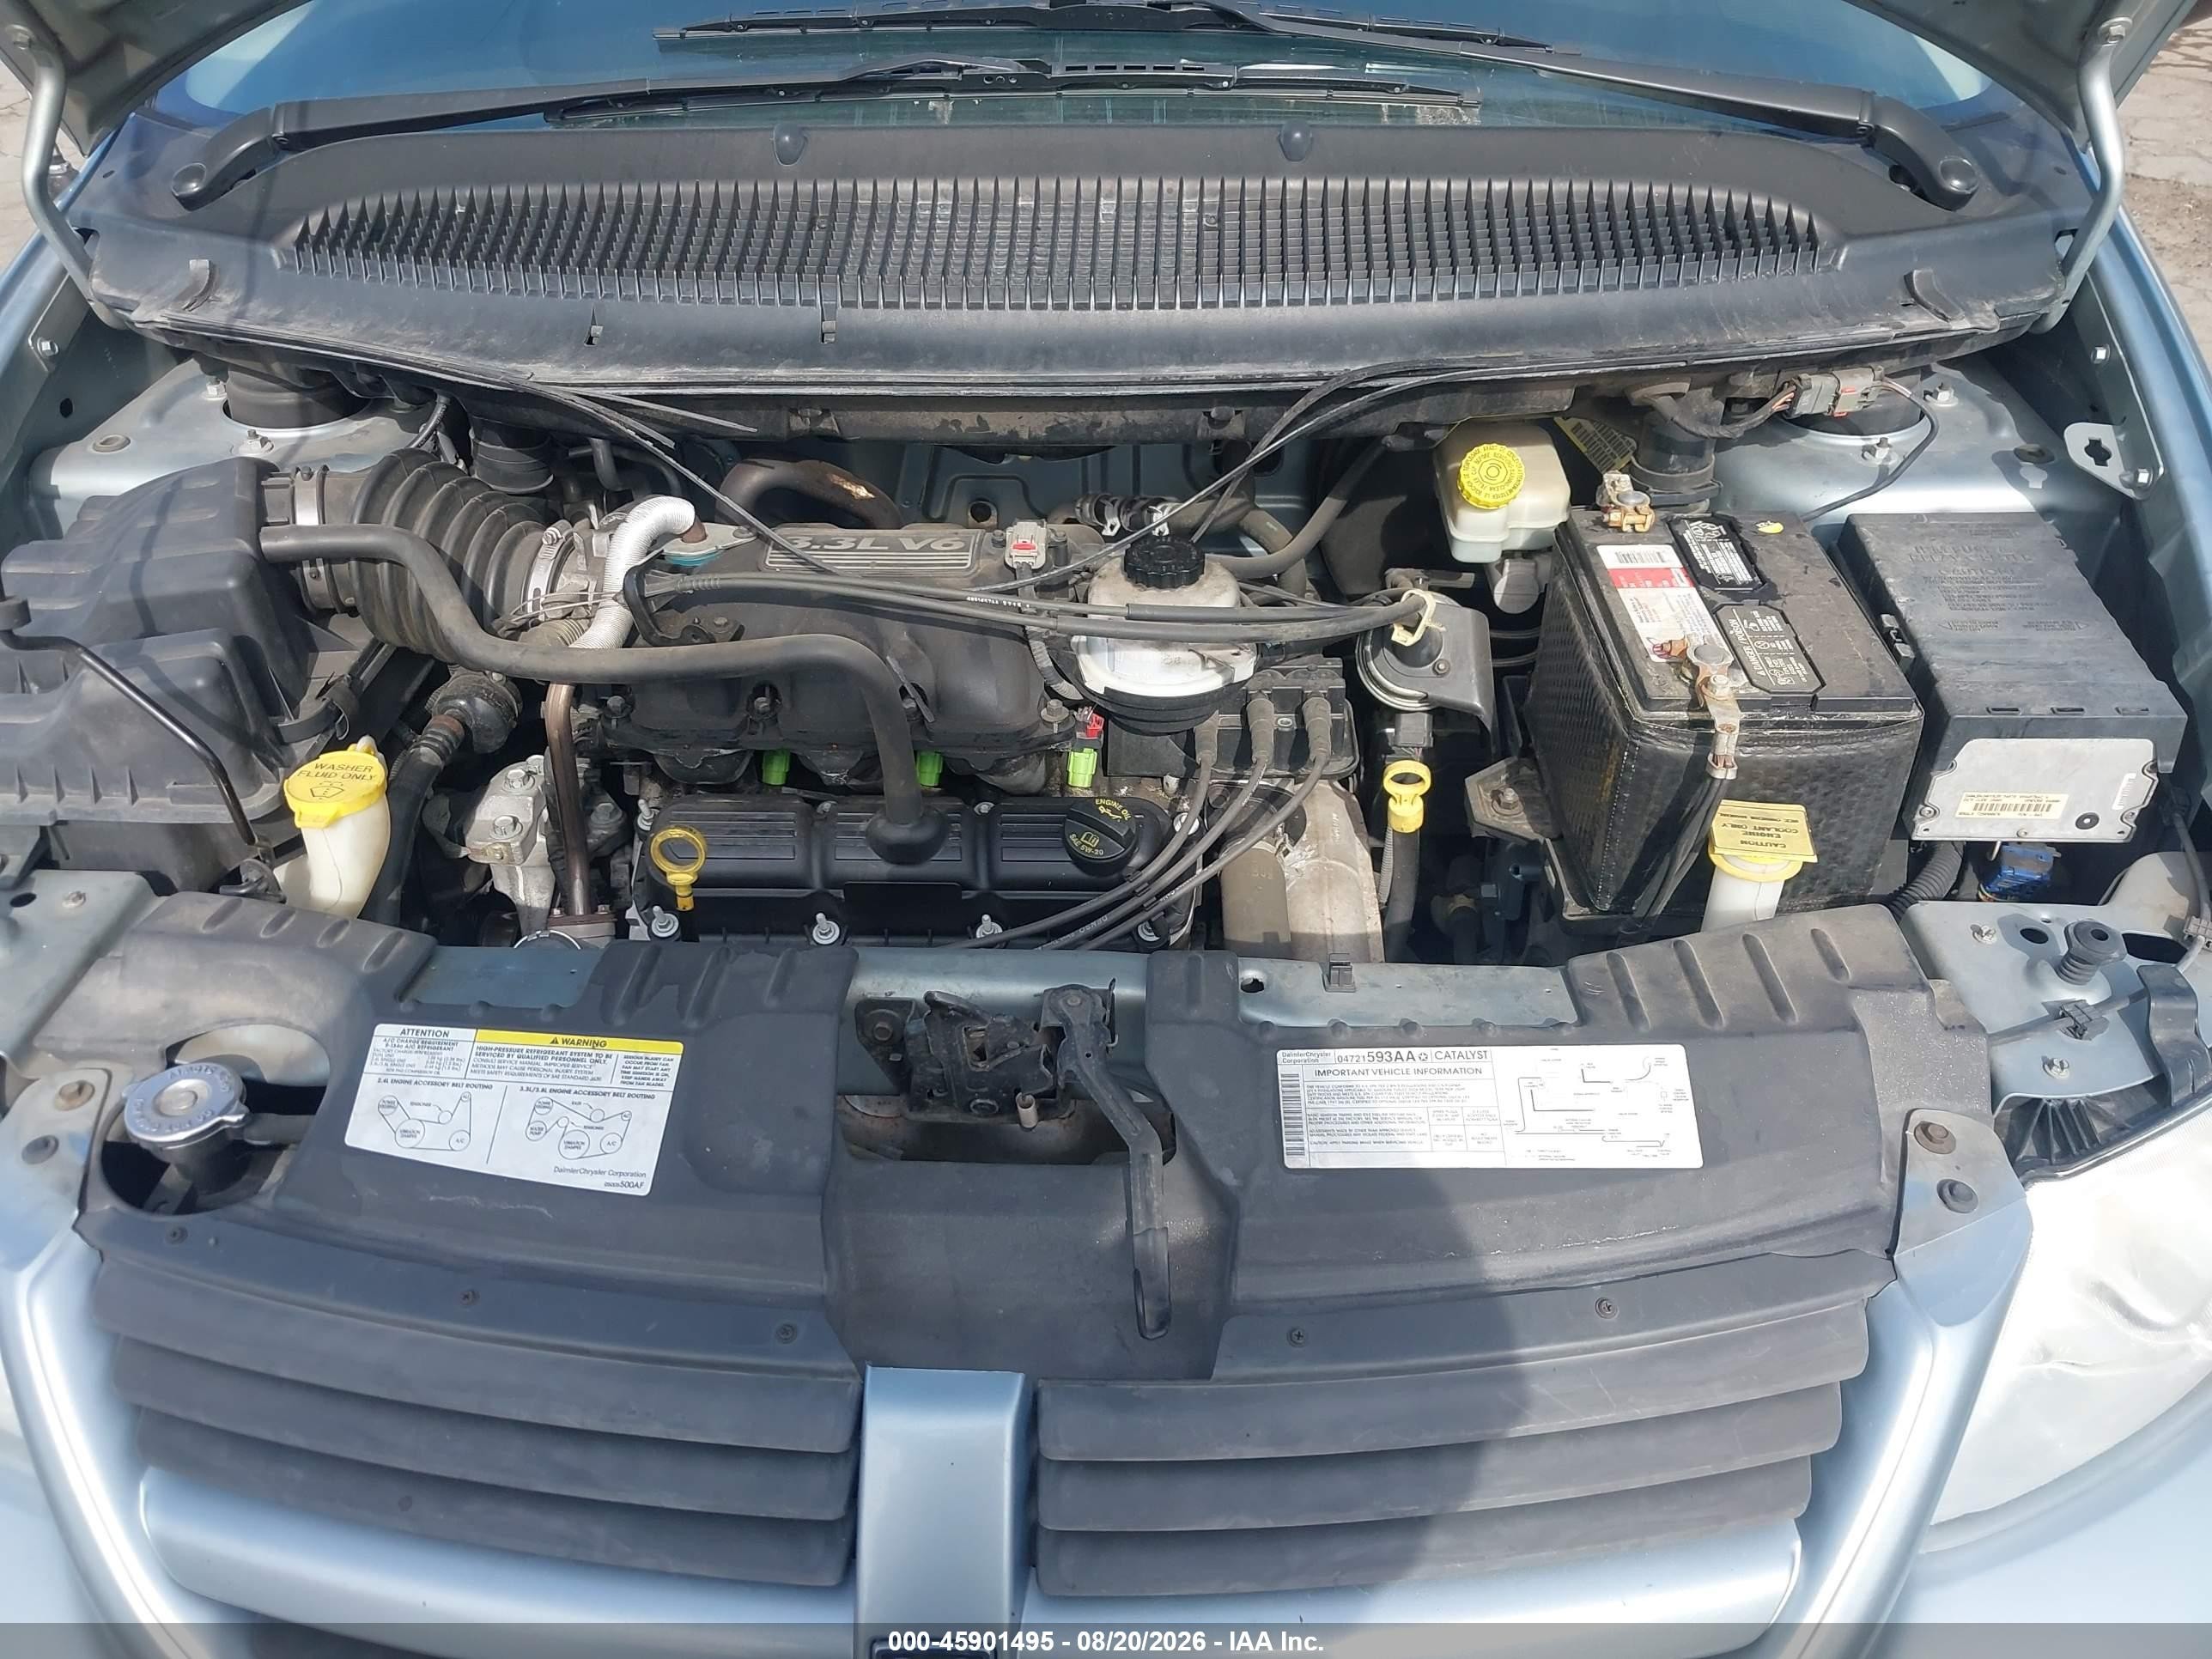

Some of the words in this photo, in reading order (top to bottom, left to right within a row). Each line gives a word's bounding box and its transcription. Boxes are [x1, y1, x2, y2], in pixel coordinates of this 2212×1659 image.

[787, 536, 889, 550] 3.3L
[899, 537, 965, 550] V6
[314, 763, 374, 773] WASHER
[342, 773, 377, 781] ONLY
[1095, 799, 1123, 811] ENGINE
[1121, 811, 1132, 821] OIL
[1753, 825, 1798, 834] COOLANT
[1069, 833, 1080, 847] SAE
[1080, 845, 1104, 856] 5W-20
[1740, 840, 1786, 848] CAUTION
[1078, 915, 1109, 933] DENSO
[400, 1029, 450, 1038] ATTENTION
[562, 1038, 607, 1048] WARNING
[1337, 1050, 1416, 1063] 04721593AA
[1434, 1050, 1488, 1060] CATALYST
[414, 1079, 450, 1088] ACCESSORY
[573, 1089, 611, 1097] ACCESSORY
[553, 1166, 606, 1176] DaimlerChrysler
[608, 1170, 647, 1178] Corporation
